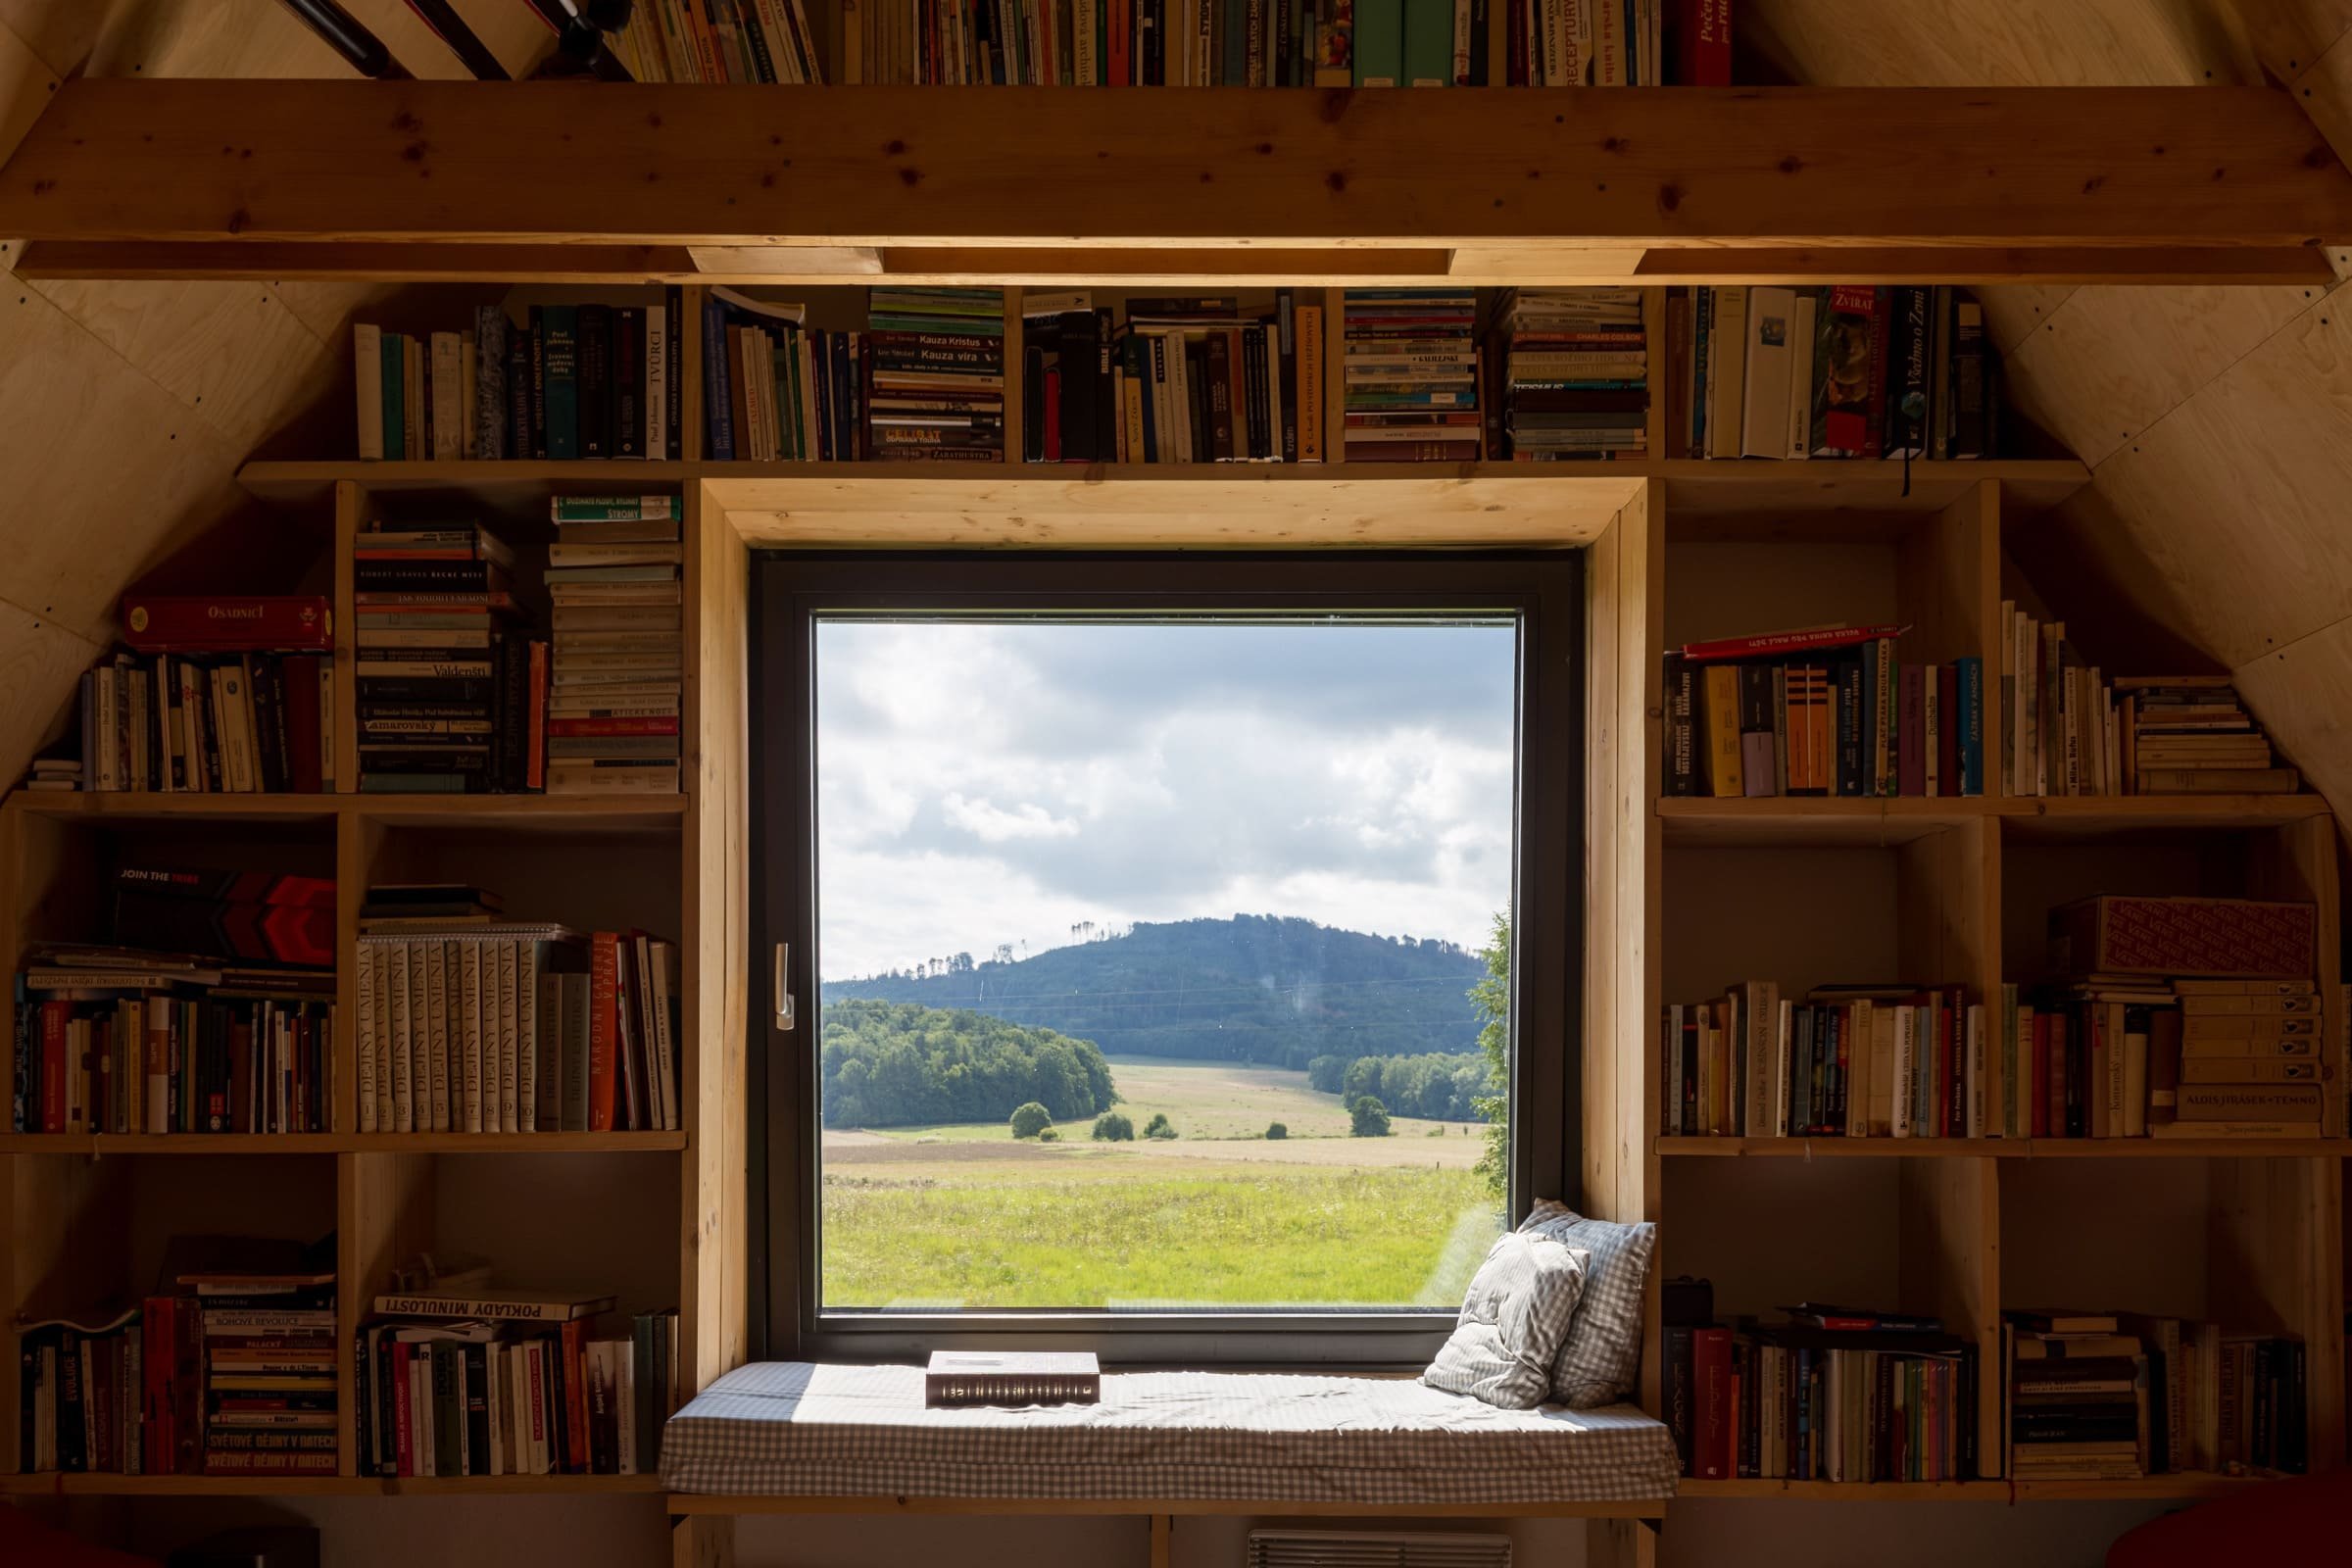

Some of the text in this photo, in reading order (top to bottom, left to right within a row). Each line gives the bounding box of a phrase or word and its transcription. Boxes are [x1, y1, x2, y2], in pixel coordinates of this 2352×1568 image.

[647, 329, 662, 383] TVŮRCI
[919, 335, 947, 346] Kauza
[949, 337, 981, 347] Kristus
[921, 349, 954, 360] Kauza
[1100, 346, 1110, 374] BIBLE
[608, 509, 639, 518] STROMY
[121, 869, 149, 880] JOIN
[150, 871, 172, 882] THE
[592, 938, 604, 999] GALERIE
[604, 938, 613, 986] PRAZE
[360, 947, 371, 1094] DEJINY UMENIA
[373, 952, 386, 1098] DEJINY UMENIA
[392, 947, 407, 1095] DEJINY UMENIA
[414, 946, 426, 1093] DEJINY UMENIA
[431, 945, 445, 1091] DEJINY UMENIA
[466, 946, 477, 1093] DEJINY UMENIA
[484, 948, 496, 1095] DEJINY UMENIA
[502, 944, 514, 1091] DEJINY UMENIA
[519, 948, 532, 1096] DEJINY UMENIA
[468, 1103, 476, 1114] 7
[2275, 1095, 2318, 1106] TEMNO
[385, 1298, 543, 1318] POKLADY MINULOSTI
[62, 1355, 78, 1402] EVOLUCE
